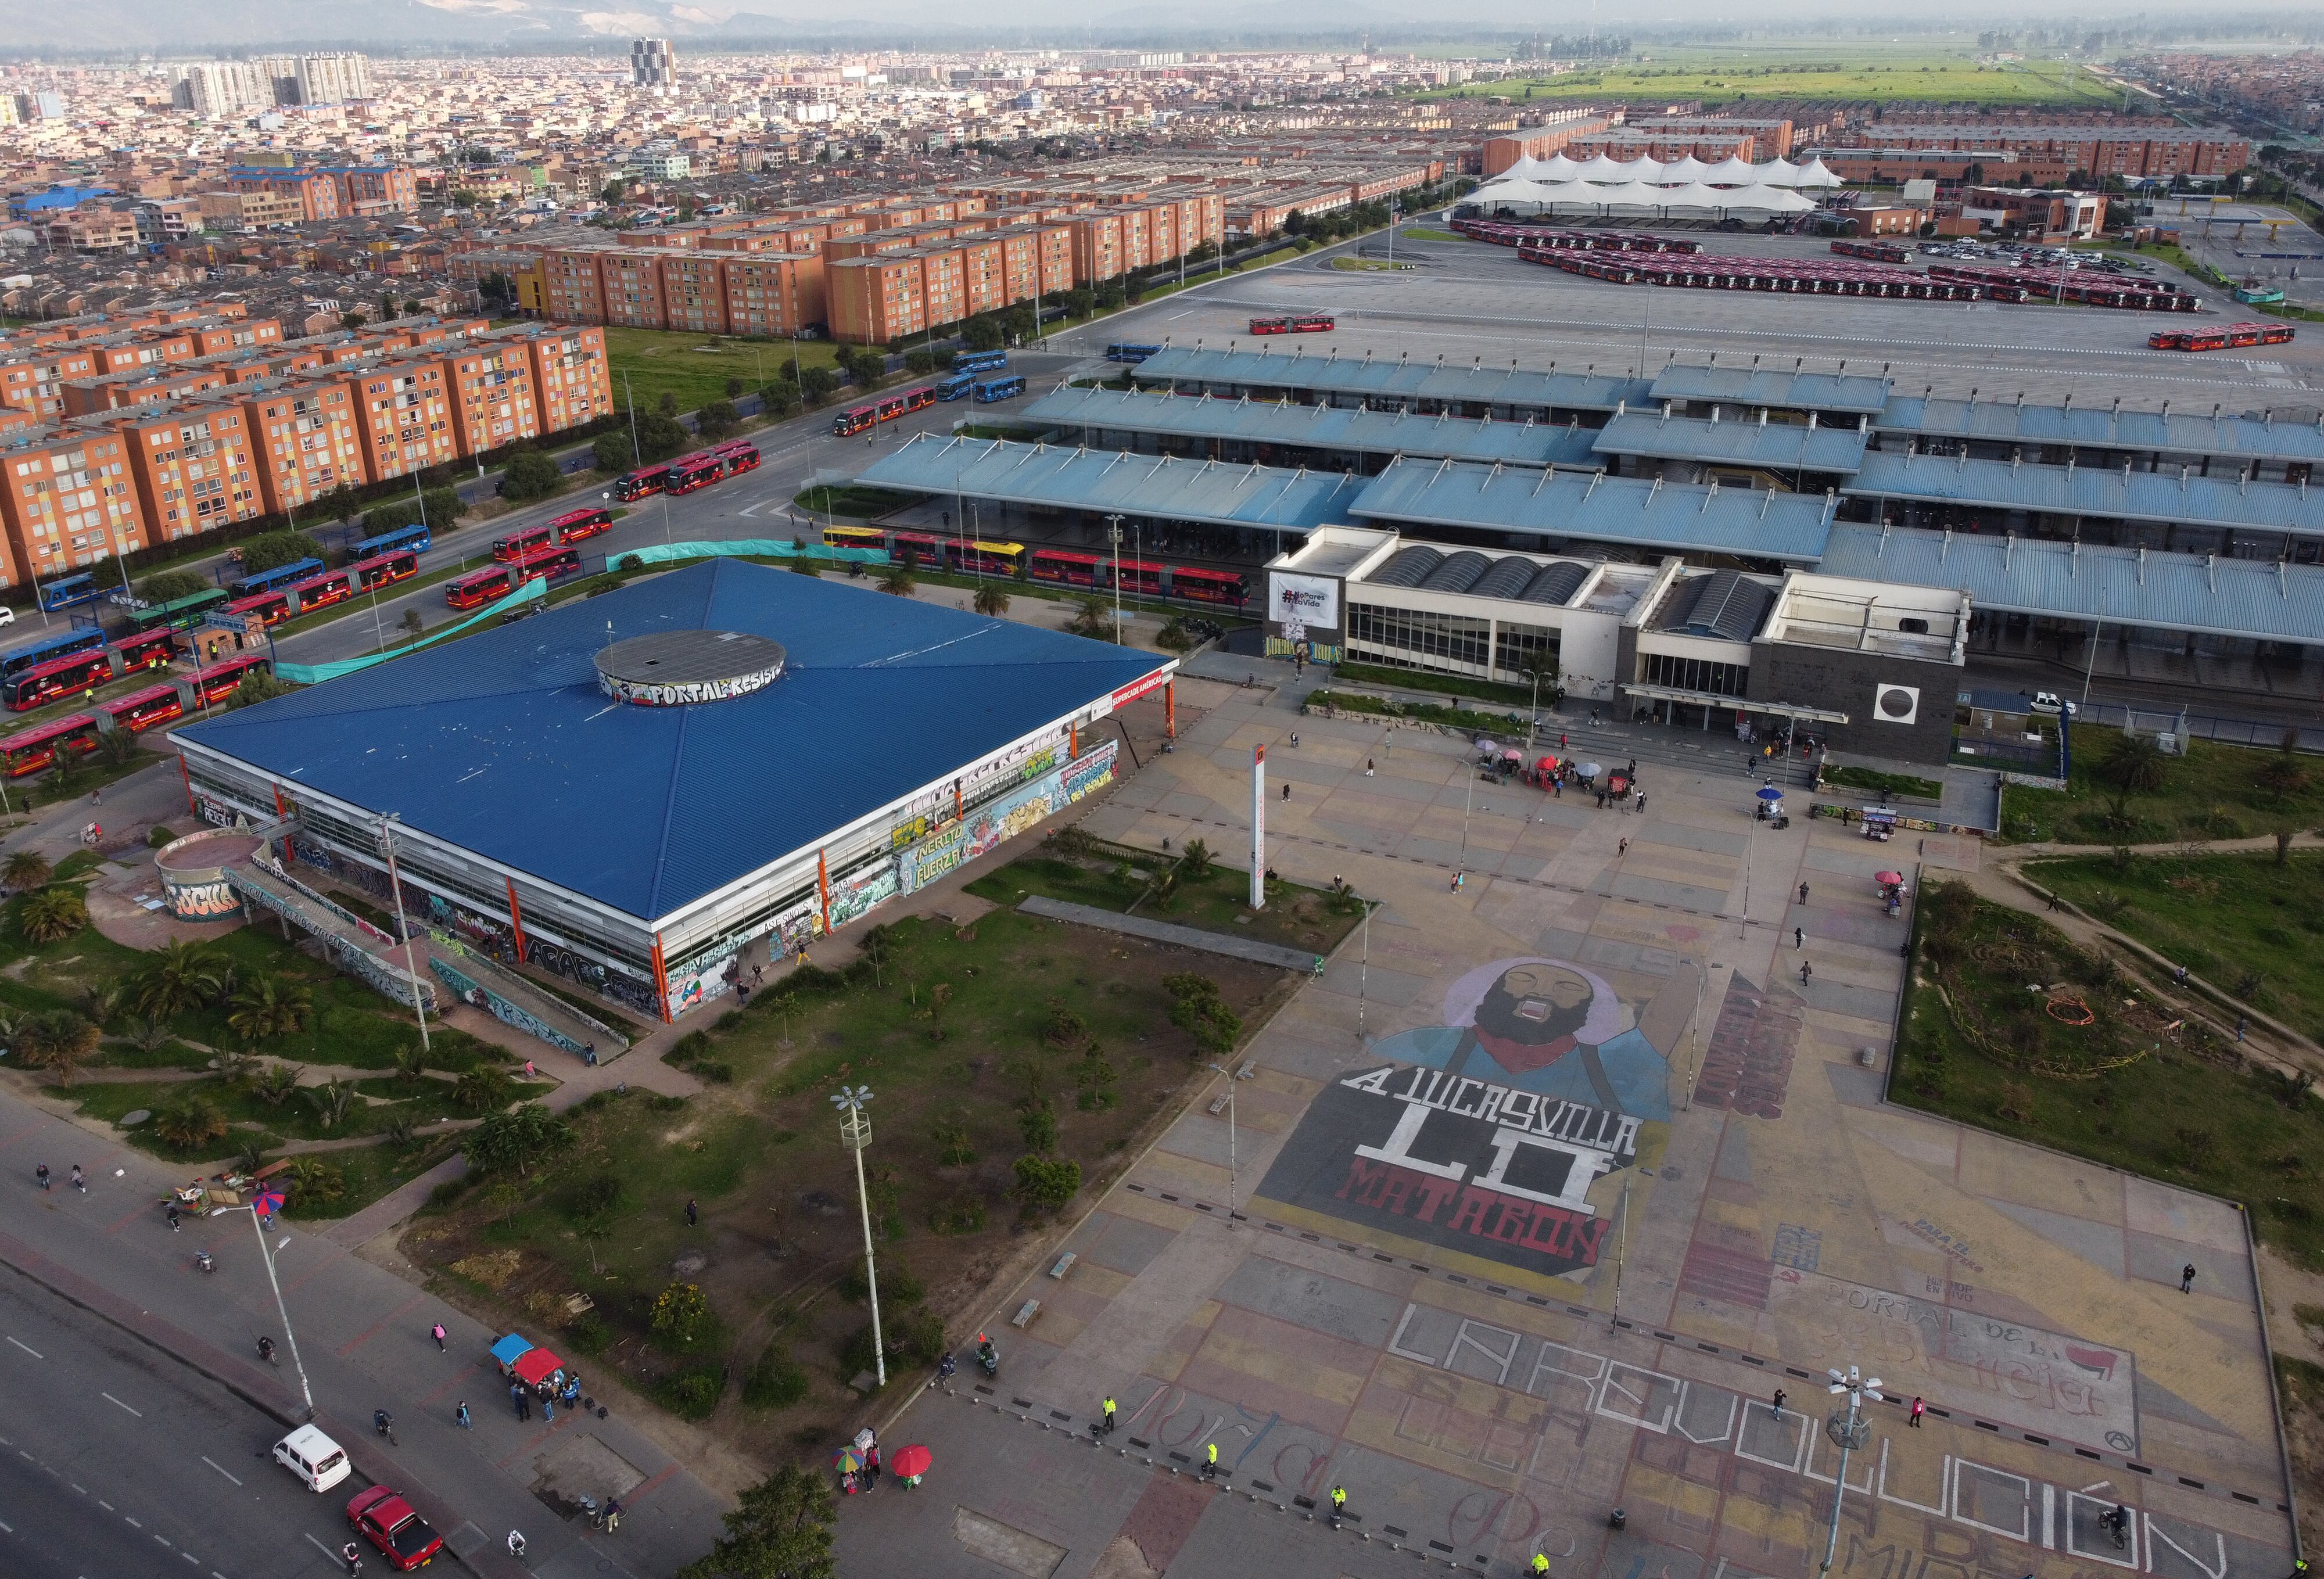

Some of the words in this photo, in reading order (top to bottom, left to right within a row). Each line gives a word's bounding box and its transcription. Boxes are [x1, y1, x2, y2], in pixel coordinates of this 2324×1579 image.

[1266, 637, 1295, 657] LUCHA
[649, 681, 727, 704] PORTAL
[1112, 687, 1139, 706] SUPERCADE
[1139, 674, 1161, 693] AMÉRICAS
[914, 848, 959, 888] FUERZA
[1339, 1068, 1394, 1096] A
[1354, 1103, 1615, 1215] LO
[1335, 1158, 1609, 1265] MATARON
